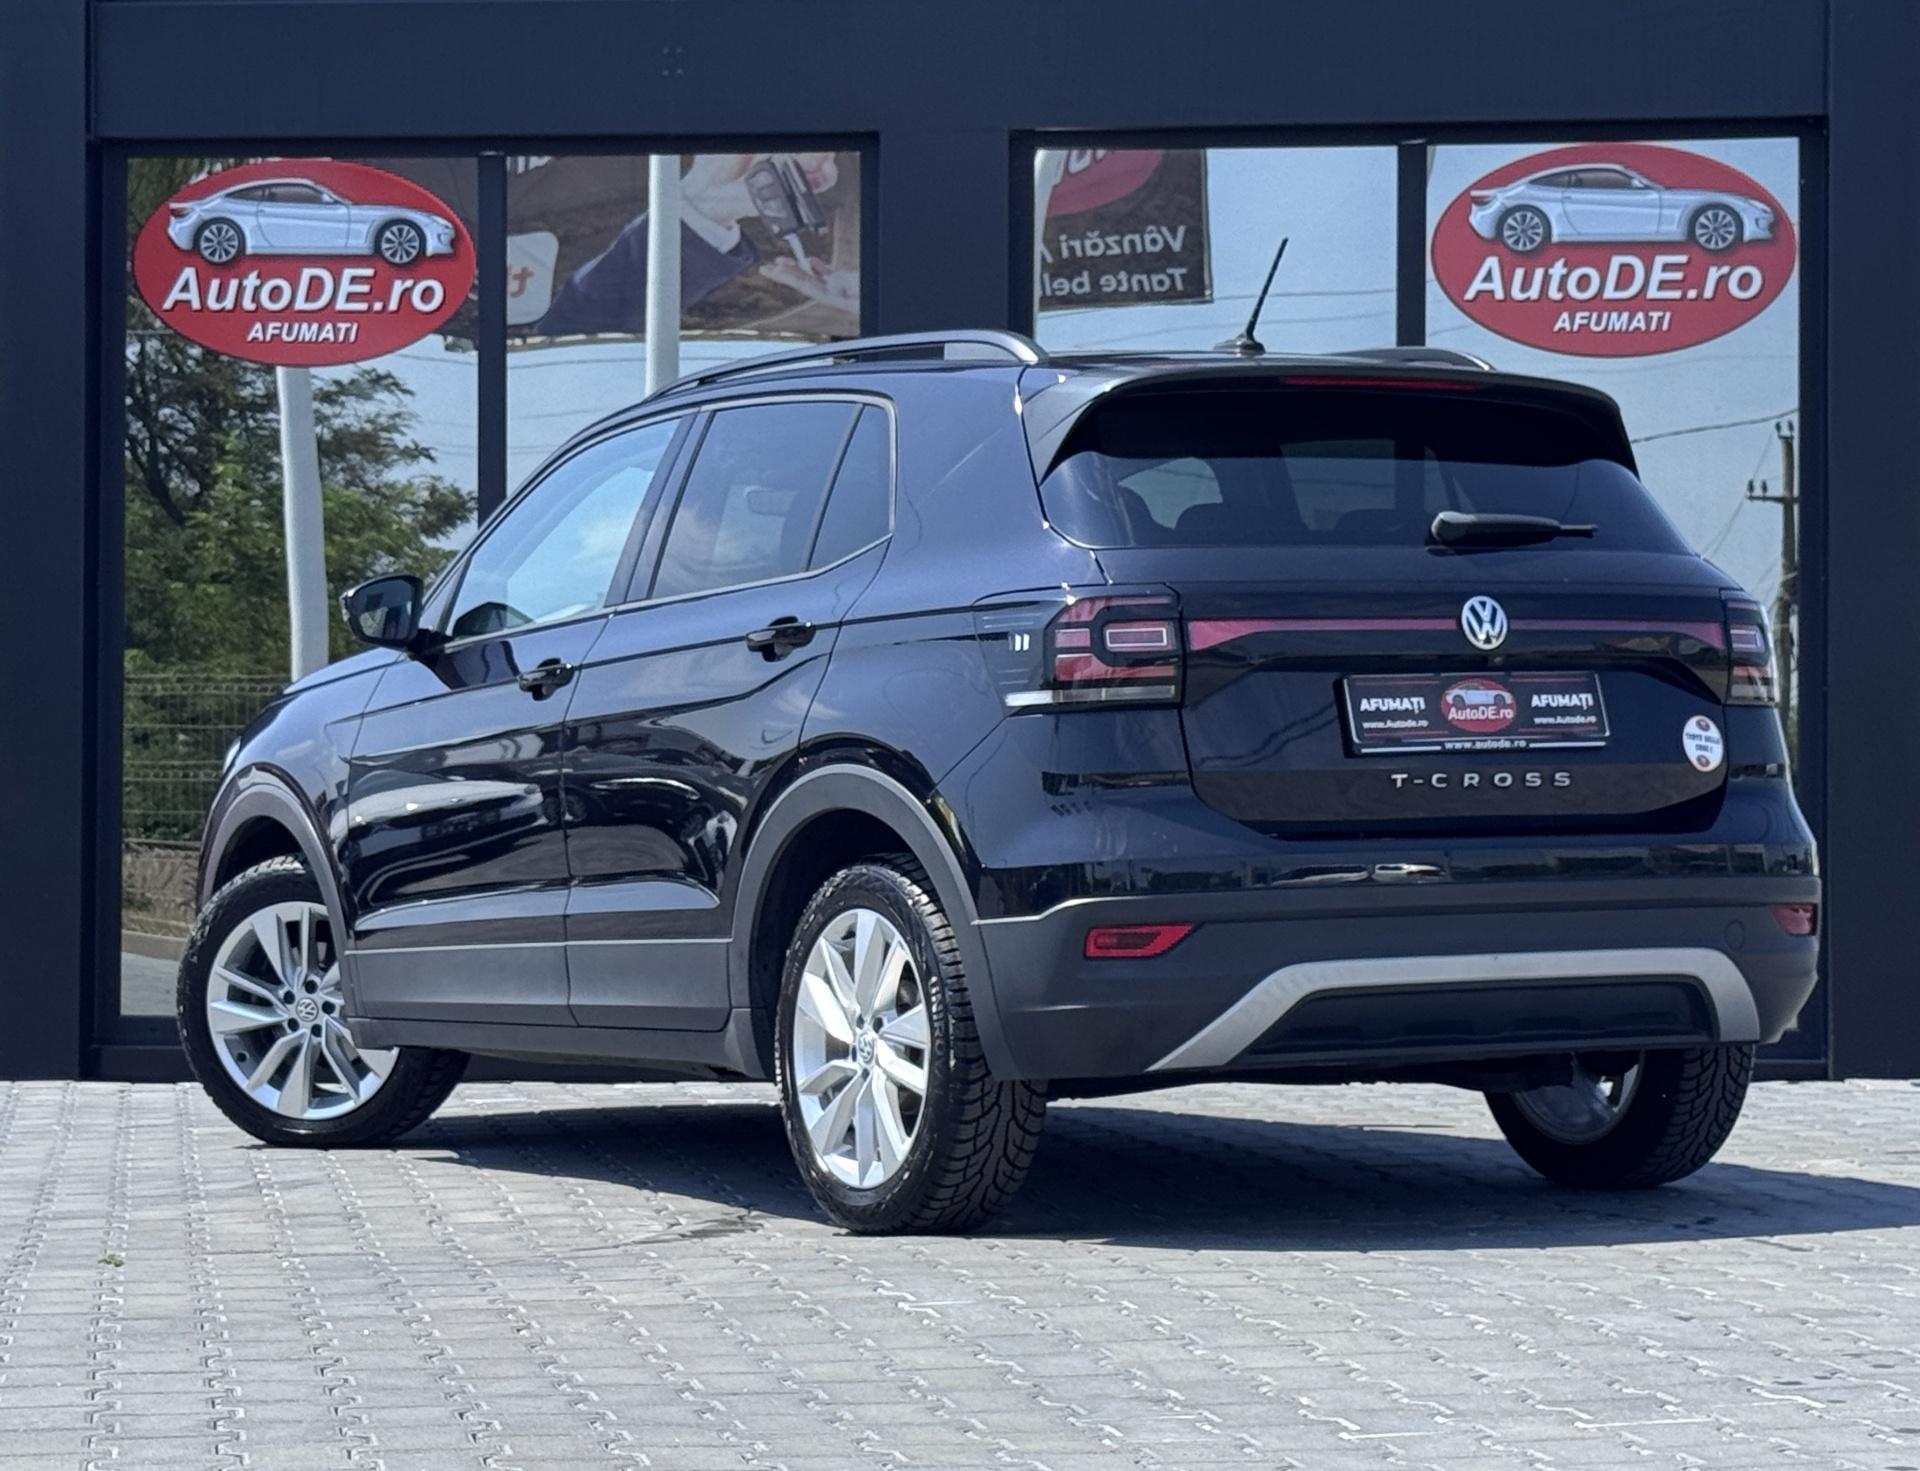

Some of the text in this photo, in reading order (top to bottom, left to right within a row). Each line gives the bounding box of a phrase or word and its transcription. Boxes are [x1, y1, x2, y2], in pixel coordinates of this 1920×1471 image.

[1463, 254, 1764, 301] AutoDE.ro
[161, 266, 445, 312] AutoDE.ro
[1553, 311, 1671, 332] AFUMATI
[246, 322, 359, 343] AFUMATI
[1448, 706, 1514, 720] AutoDE.ro
